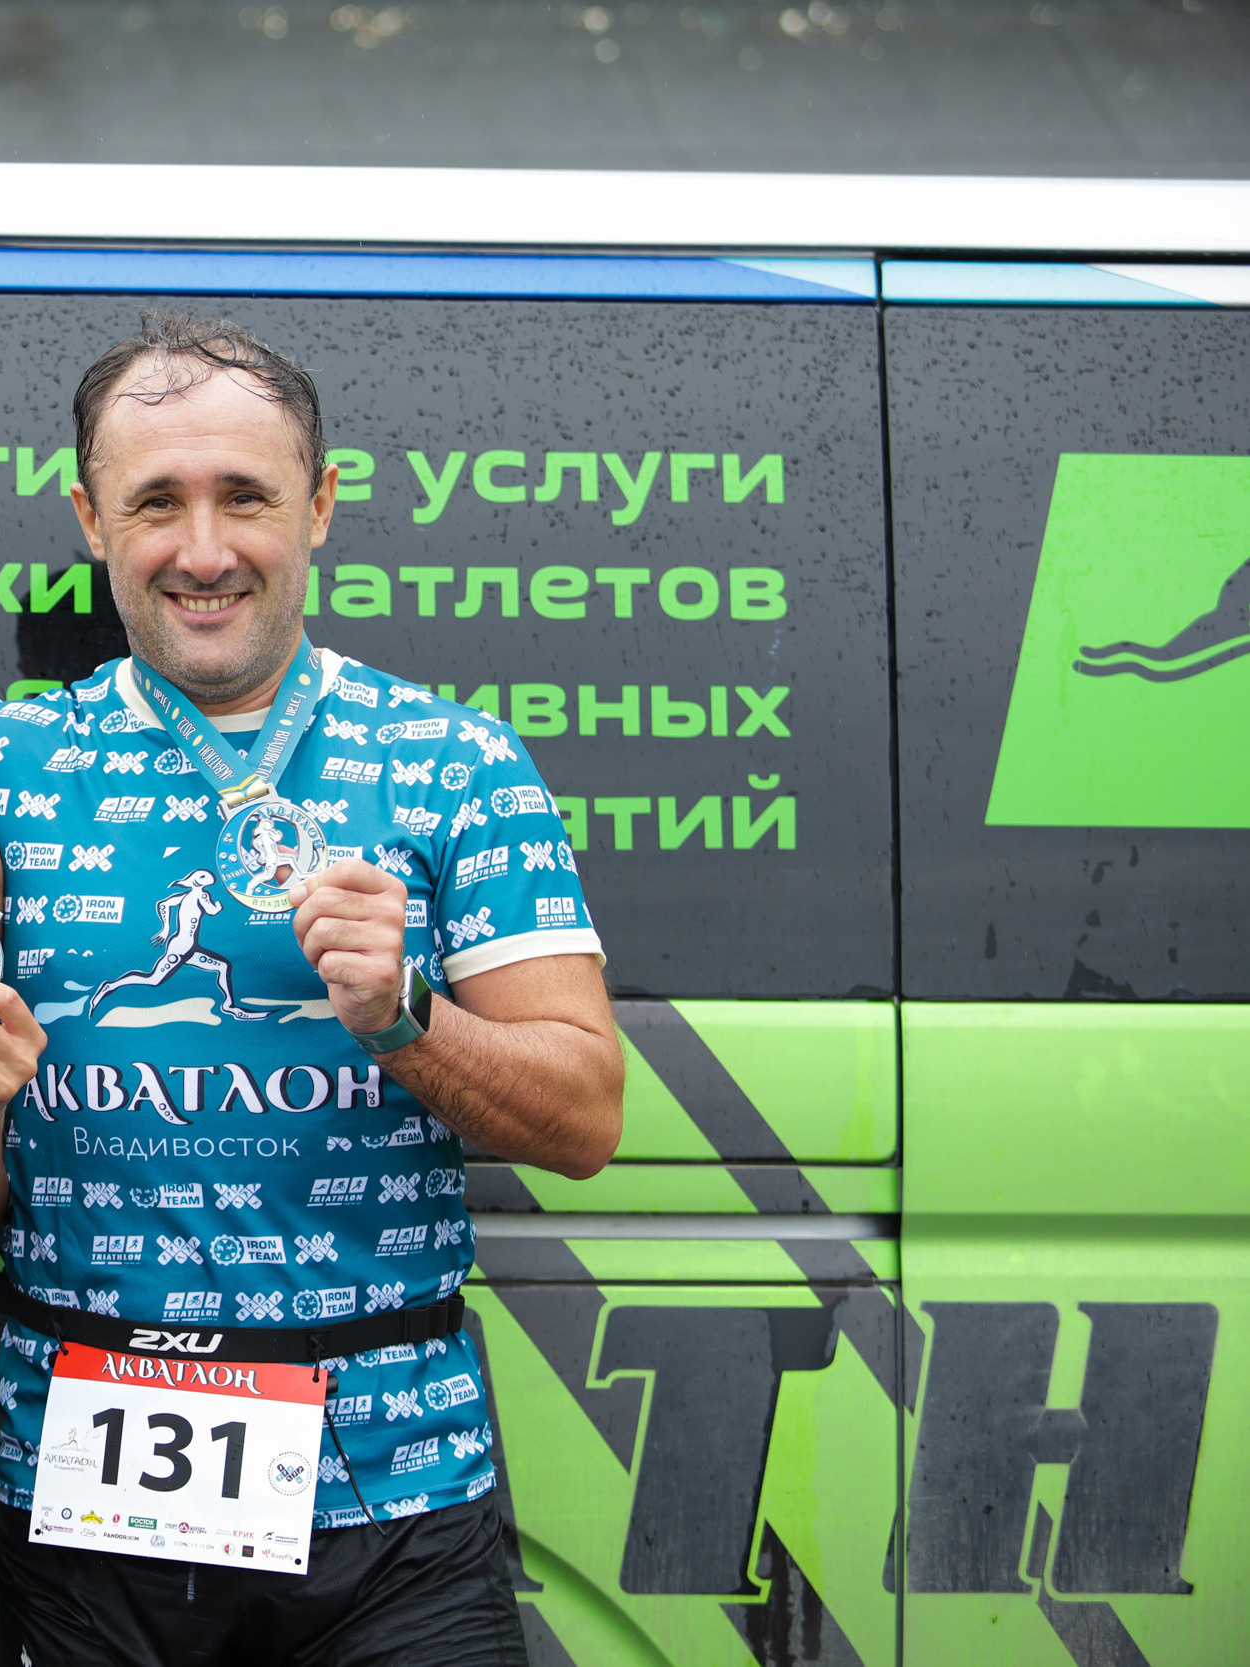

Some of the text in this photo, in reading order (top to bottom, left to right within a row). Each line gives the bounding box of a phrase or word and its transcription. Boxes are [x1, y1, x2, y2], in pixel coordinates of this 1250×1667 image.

[406, 450, 785, 526] услуги
[343, 682, 370, 695] IRON
[342, 692, 374, 705] TEAM
[176, 716, 196, 740] 2022
[411, 721, 440, 729] IRON
[410, 729, 443, 738] TEAM
[255, 729, 292, 782] ВЛАДИВОСТО
[322, 770, 379, 782] TRIATHLON
[519, 789, 539, 798] IRON
[524, 801, 546, 810] TEAM
[95, 810, 149, 819] TRIATHLON
[29, 846, 55, 855] IRON
[329, 849, 355, 858] RON
[29, 858, 57, 867] TEAM
[455, 863, 508, 886] TRIATHLON
[85, 899, 116, 908] IRON
[84, 910, 119, 920] TEAM
[248, 913, 291, 921] ATHLON
[536, 914, 577, 924] TRIATHLON
[17, 966, 43, 975] TRIATHL
[23, 1062, 384, 1126] АКВАТЛОН
[395, 1131, 422, 1143] TEAM
[73, 1126, 300, 1161] Владивосток
[163, 1183, 194, 1193] IRON
[31, 1195, 72, 1203] TRIATHLON
[164, 1196, 200, 1205] TEAM
[309, 1194, 363, 1202] TRIATHLON
[246, 1240, 277, 1249] IRON
[376, 1242, 424, 1253] TRIATHLON
[91, 1253, 141, 1261] TRIATHLON
[248, 1251, 283, 1261] TEAM
[324, 1291, 350, 1302] IRON
[326, 1302, 354, 1314] TEAM
[162, 1310, 219, 1318] TRIATHLON
[129, 1328, 223, 1353] 2XU
[385, 1349, 414, 1360] TEAM
[101, 1353, 266, 1395] АКВАТЛОН
[450, 1378, 469, 1389] IRON
[454, 1389, 476, 1401] TEAM
[92, 1407, 247, 1499] 131
[390, 1454, 439, 1471] TRIATHLON
[335, 1511, 365, 1521] IRON
[233, 1530, 255, 1539] КРИК
